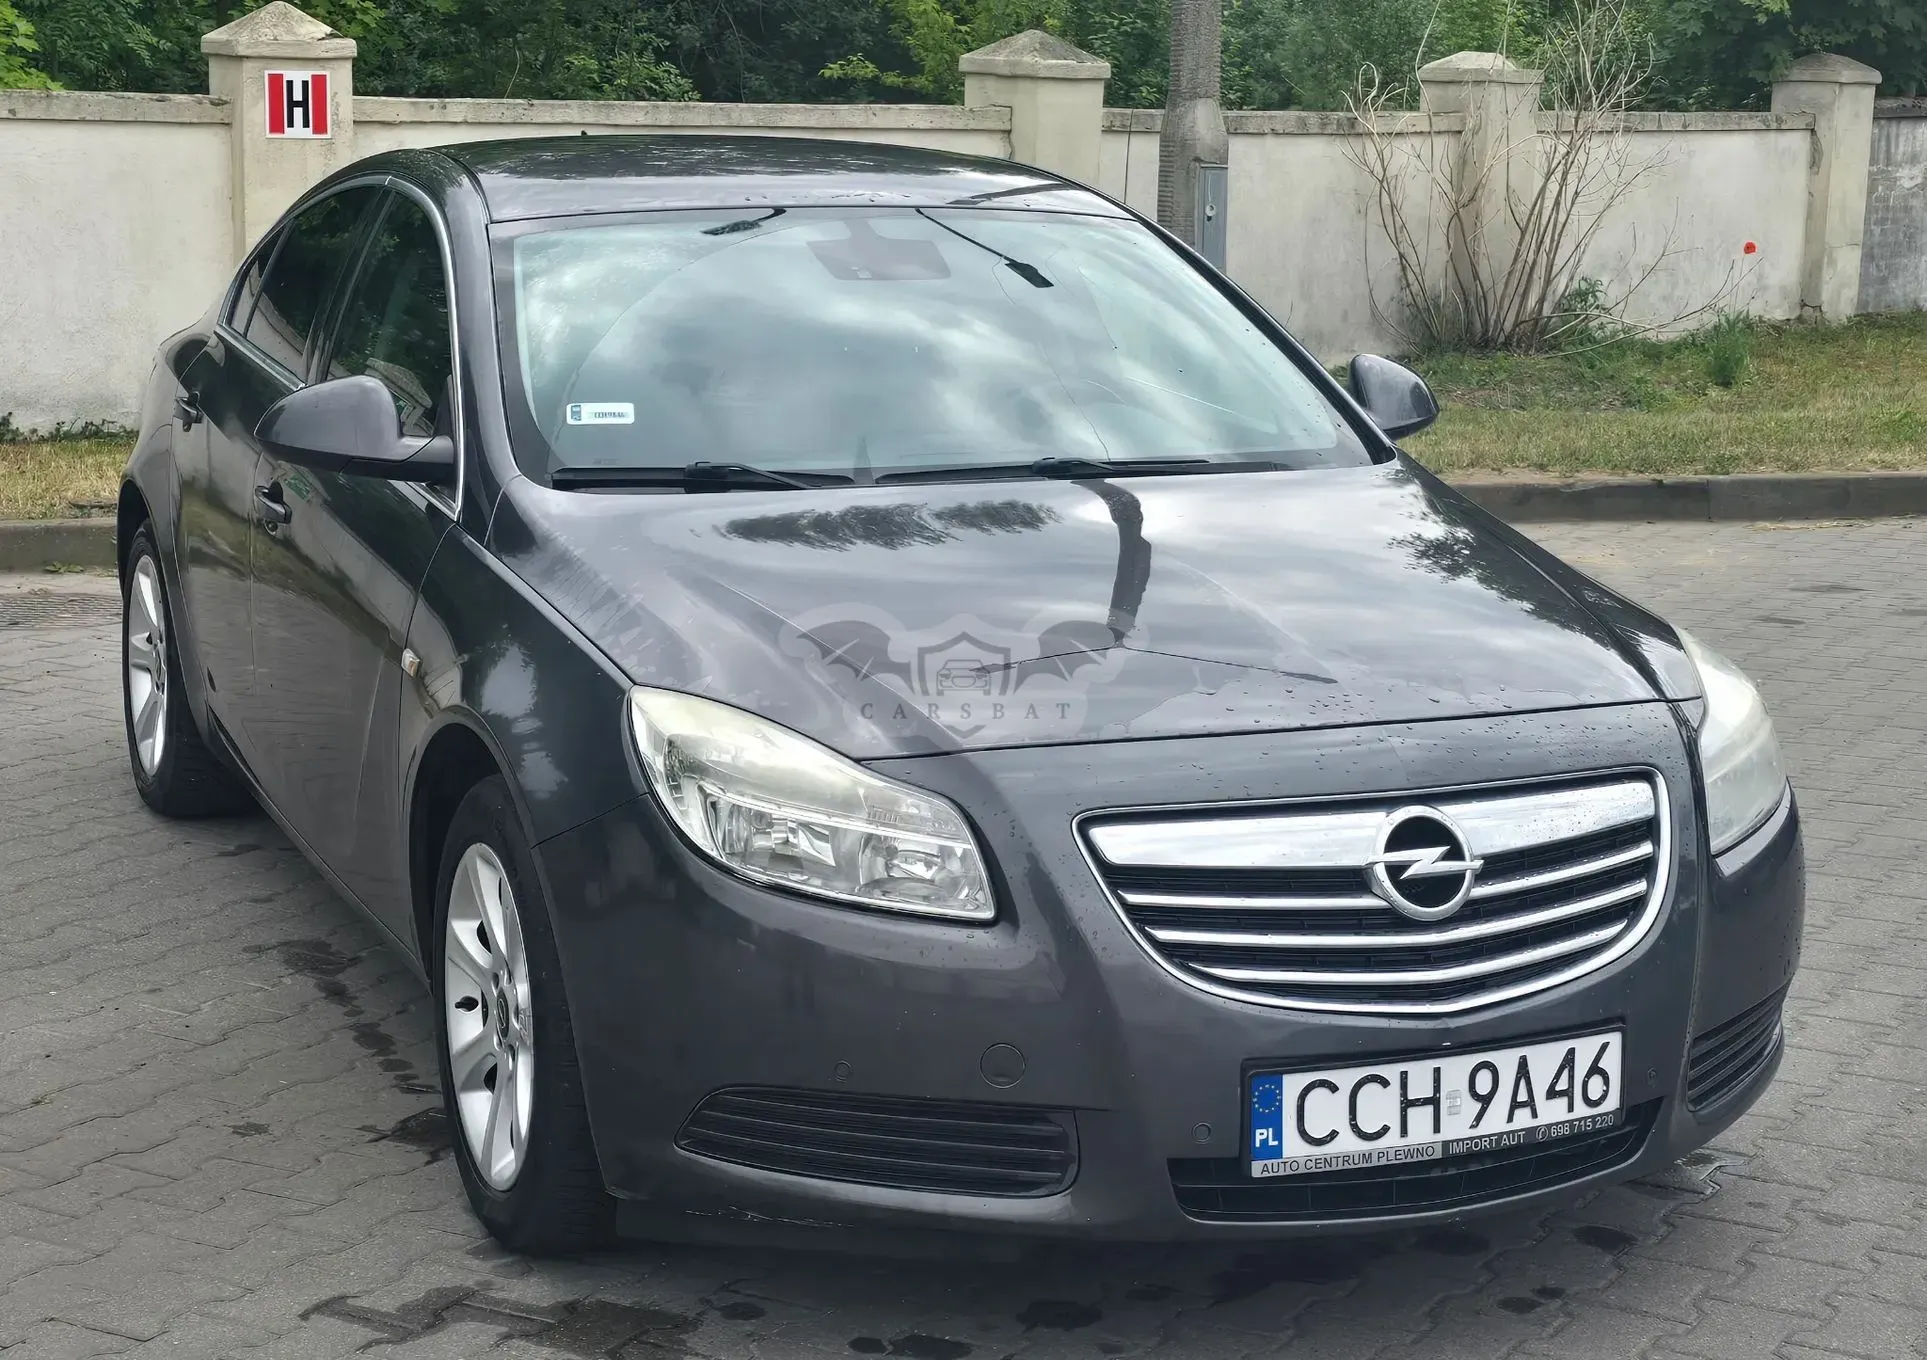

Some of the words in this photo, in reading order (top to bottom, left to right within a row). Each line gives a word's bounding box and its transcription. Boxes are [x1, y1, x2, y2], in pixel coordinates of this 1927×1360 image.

[286, 80, 309, 128] H
[1296, 1067, 1441, 1146] CCH
[1468, 1041, 1611, 1129] 9A46
[1255, 1128, 1279, 1147] PL
[1550, 1122, 1571, 1138] 698
[1573, 1118, 1593, 1133] 715
[1595, 1114, 1614, 1128] 220
[1449, 1136, 1498, 1154] IMPORT
[1501, 1131, 1526, 1148] AUT
[1260, 1158, 1300, 1175] AUTO
[1304, 1153, 1374, 1171] CENTRUM
[1377, 1146, 1435, 1164] PLEWNO
